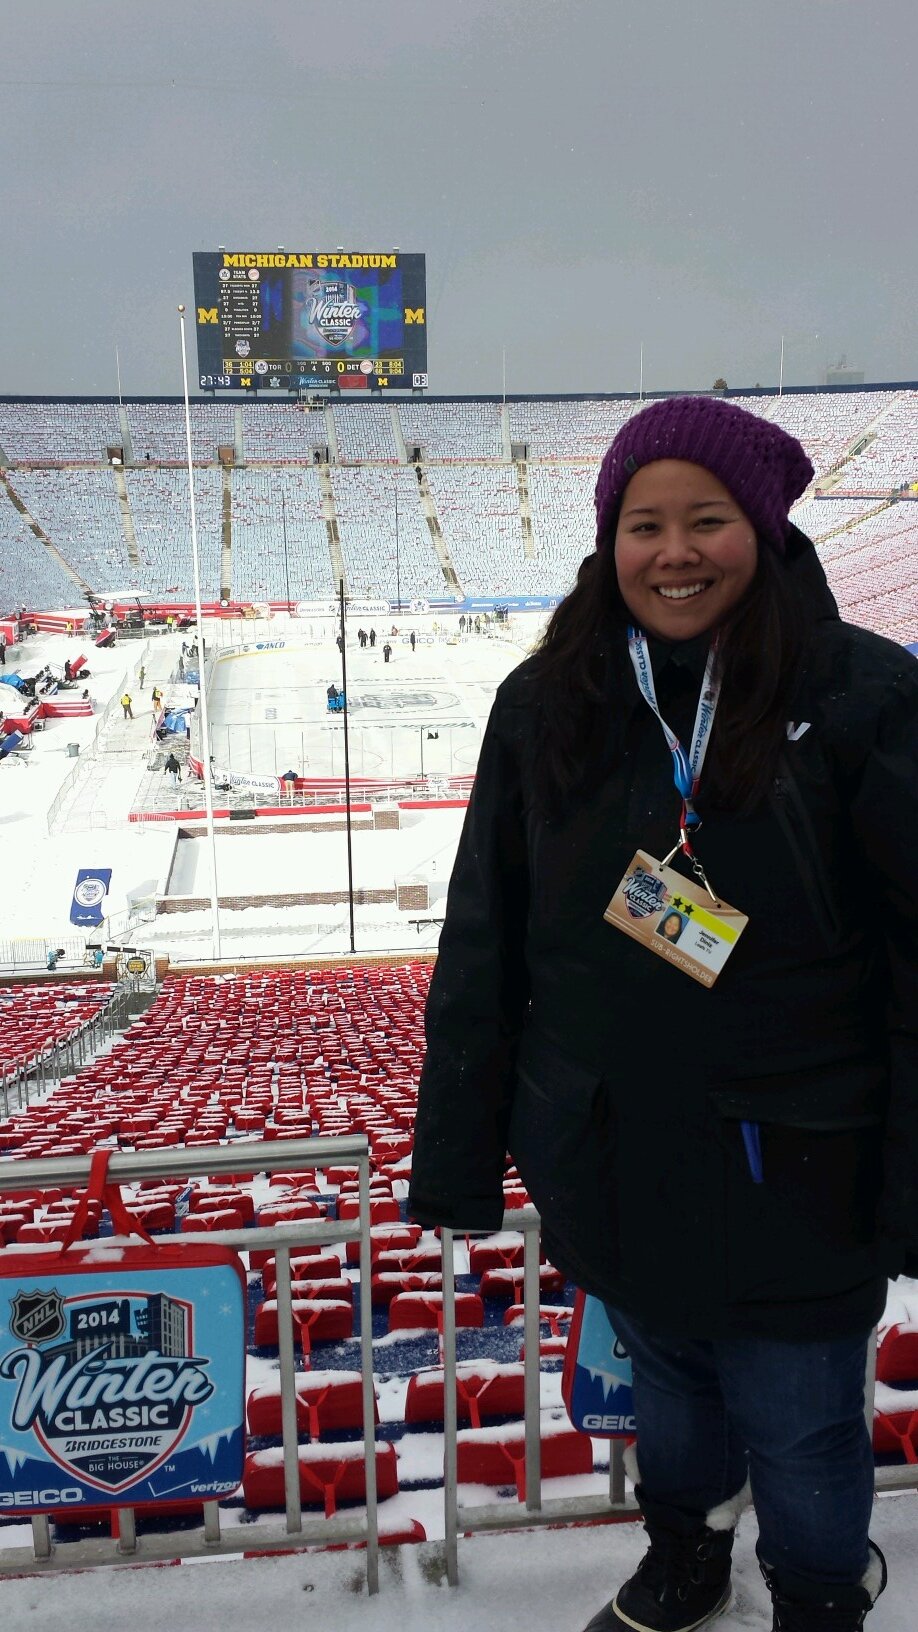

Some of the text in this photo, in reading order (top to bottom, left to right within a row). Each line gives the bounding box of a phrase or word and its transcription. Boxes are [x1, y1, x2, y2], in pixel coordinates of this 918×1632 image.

[224, 254, 396, 268] MICHIGAN STADIUM
[198, 308, 218, 324] M
[306, 298, 362, 324] Winter
[404, 308, 424, 324] M
[286, 362, 292, 372] 0
[337, 362, 344, 373] 0
[200, 376, 230, 386] 27:43
[240, 378, 251, 386] M
[635, 640, 646, 670] CLASSIC
[691, 701, 714, 773] Winter CLASSIC
[623, 876, 664, 911] Winter
[630, 894, 652, 912] CLASSIC
[651, 940, 713, 984] SUB-RIGHTSHOLDER
[22, 1302, 55, 1334] NHL
[77, 1308, 120, 1330] 2014
[1, 1341, 214, 1429] Winter
[54, 1404, 168, 1431] CLASSIC
[64, 1436, 162, 1452] BRIDGESTONE
[89, 1464, 104, 1472] BIG
